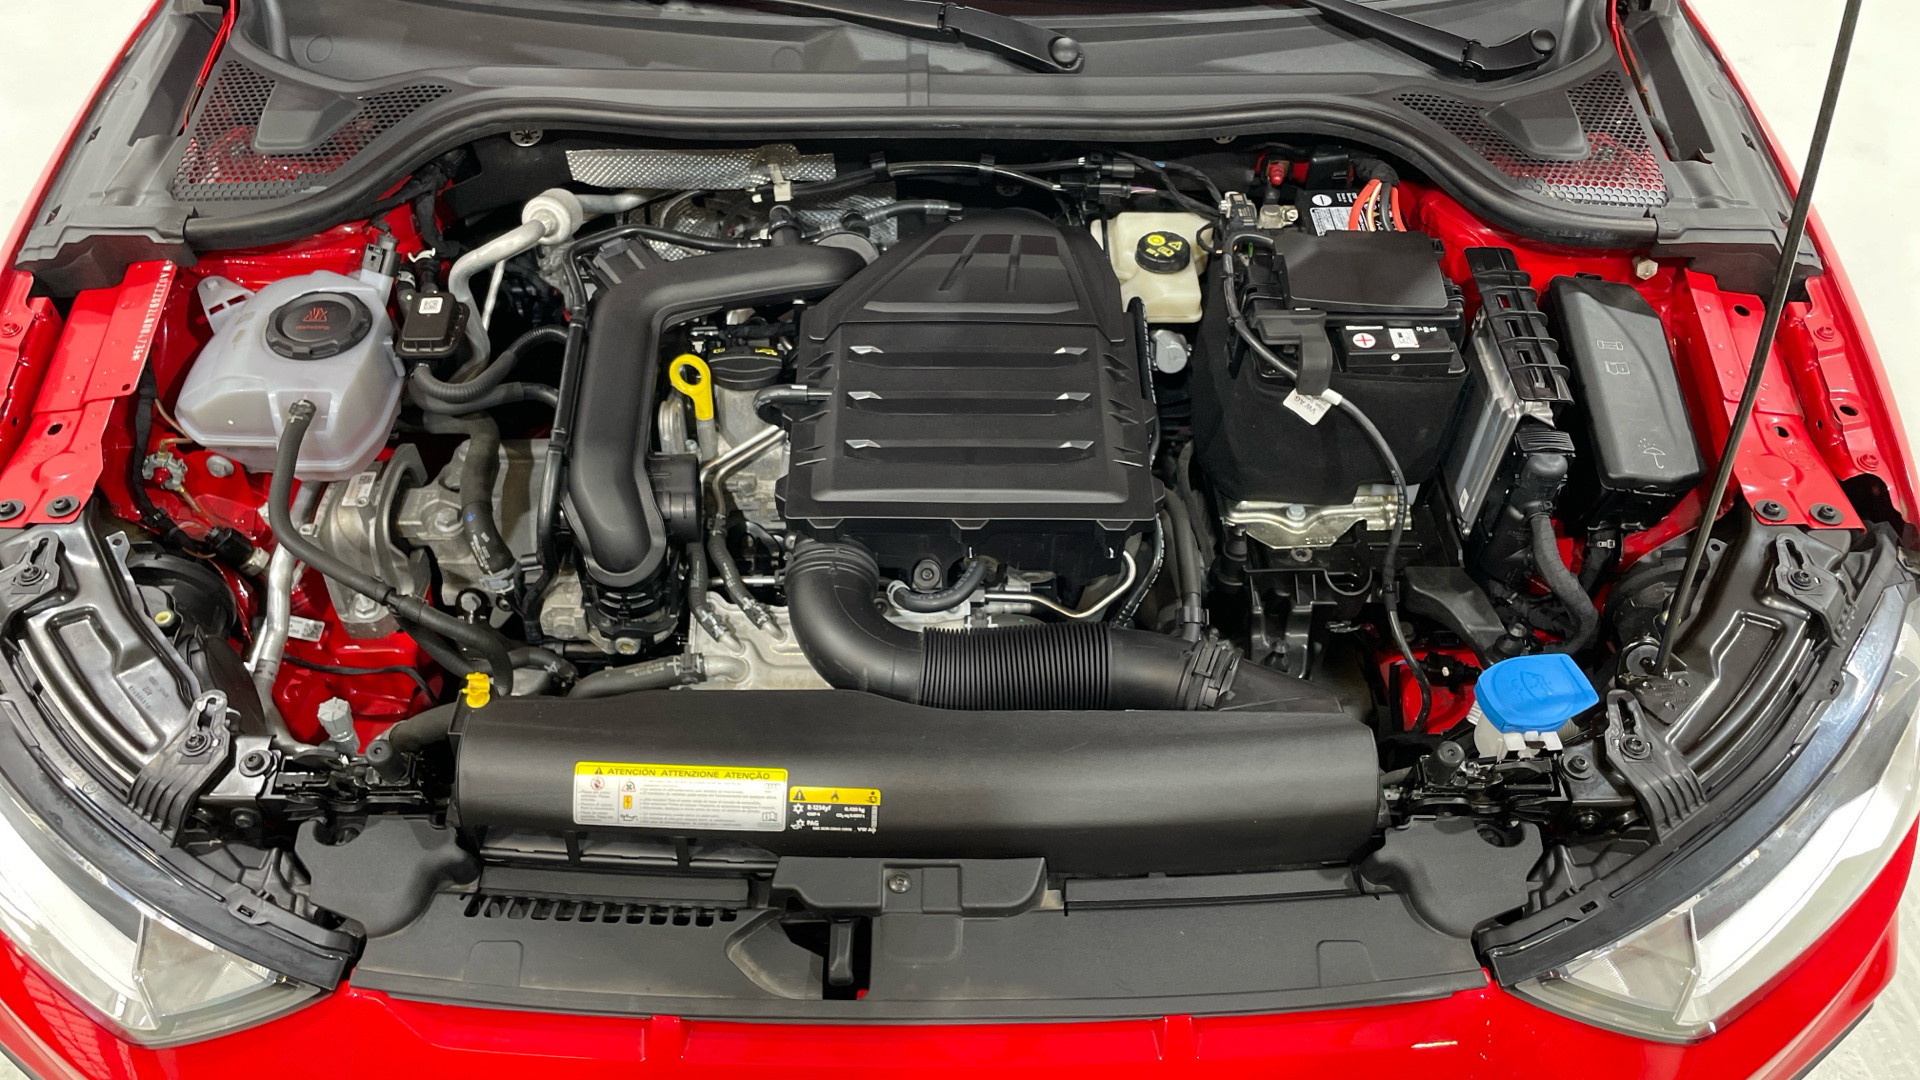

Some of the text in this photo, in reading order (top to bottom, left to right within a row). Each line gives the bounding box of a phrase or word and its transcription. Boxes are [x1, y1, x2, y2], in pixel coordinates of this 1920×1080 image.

[607, 767, 770, 781] ATENCIÓN ATTENZIONE ATENÇÃO
